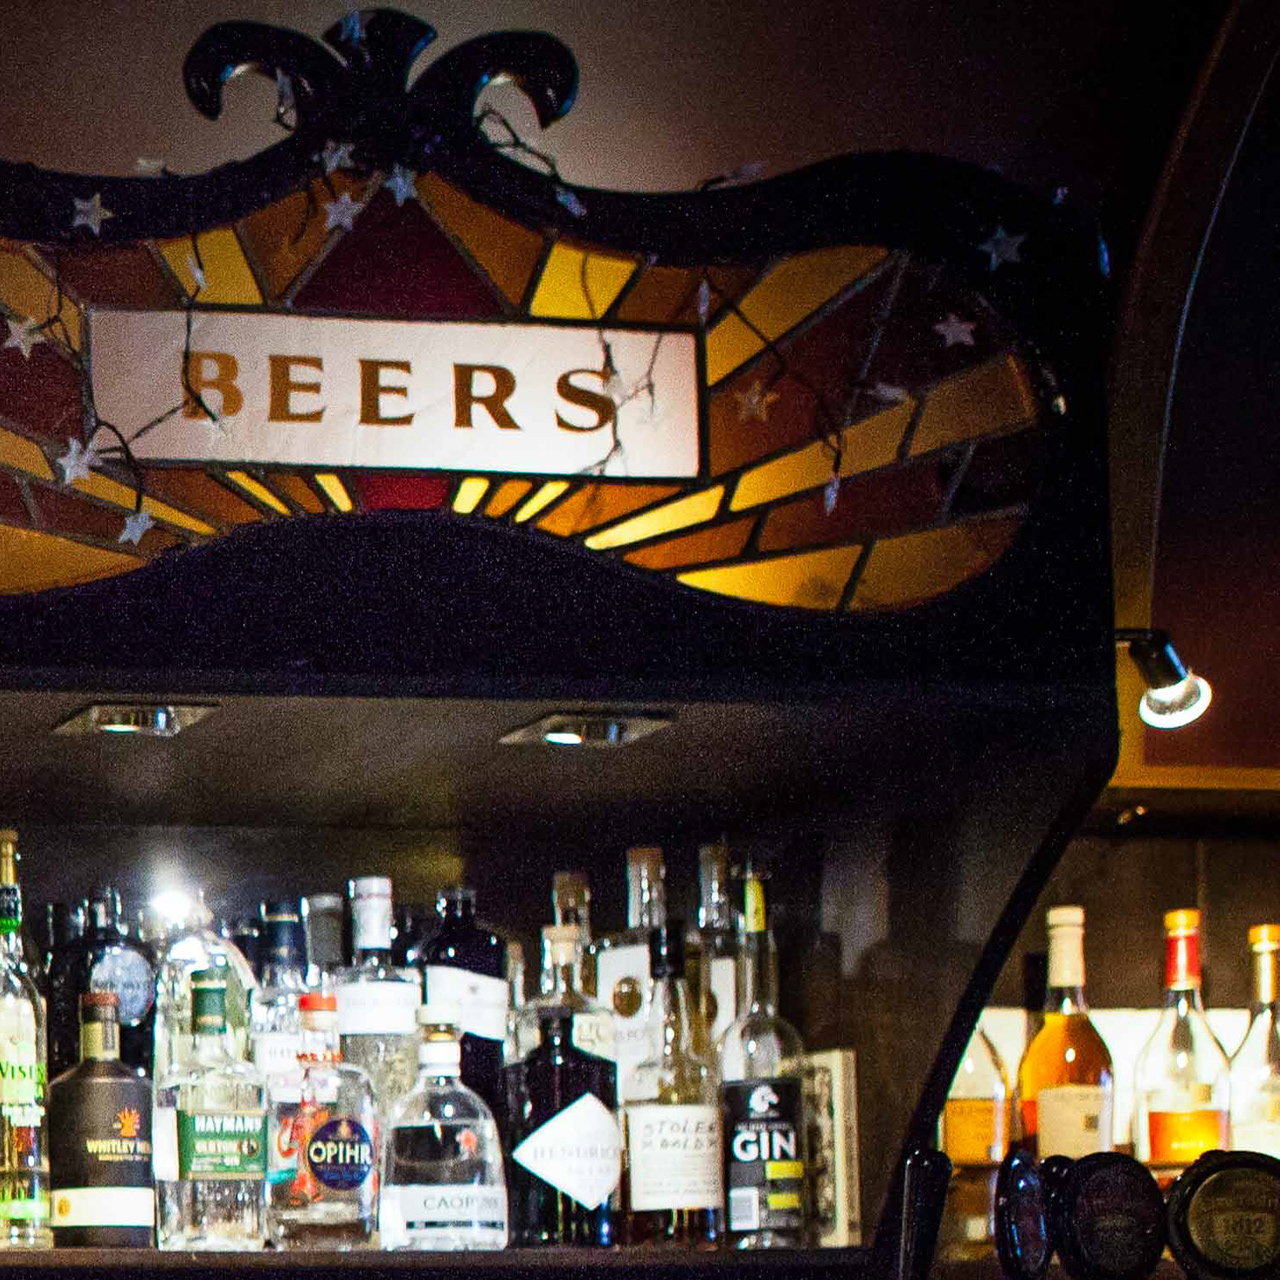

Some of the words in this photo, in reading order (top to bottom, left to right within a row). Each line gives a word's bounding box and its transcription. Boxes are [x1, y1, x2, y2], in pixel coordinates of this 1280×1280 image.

[182, 358, 616, 434] BEERS
[86, 1139, 135, 1154] WHITLEY
[309, 1141, 373, 1165] OPIHR
[732, 1130, 796, 1163] GIN
